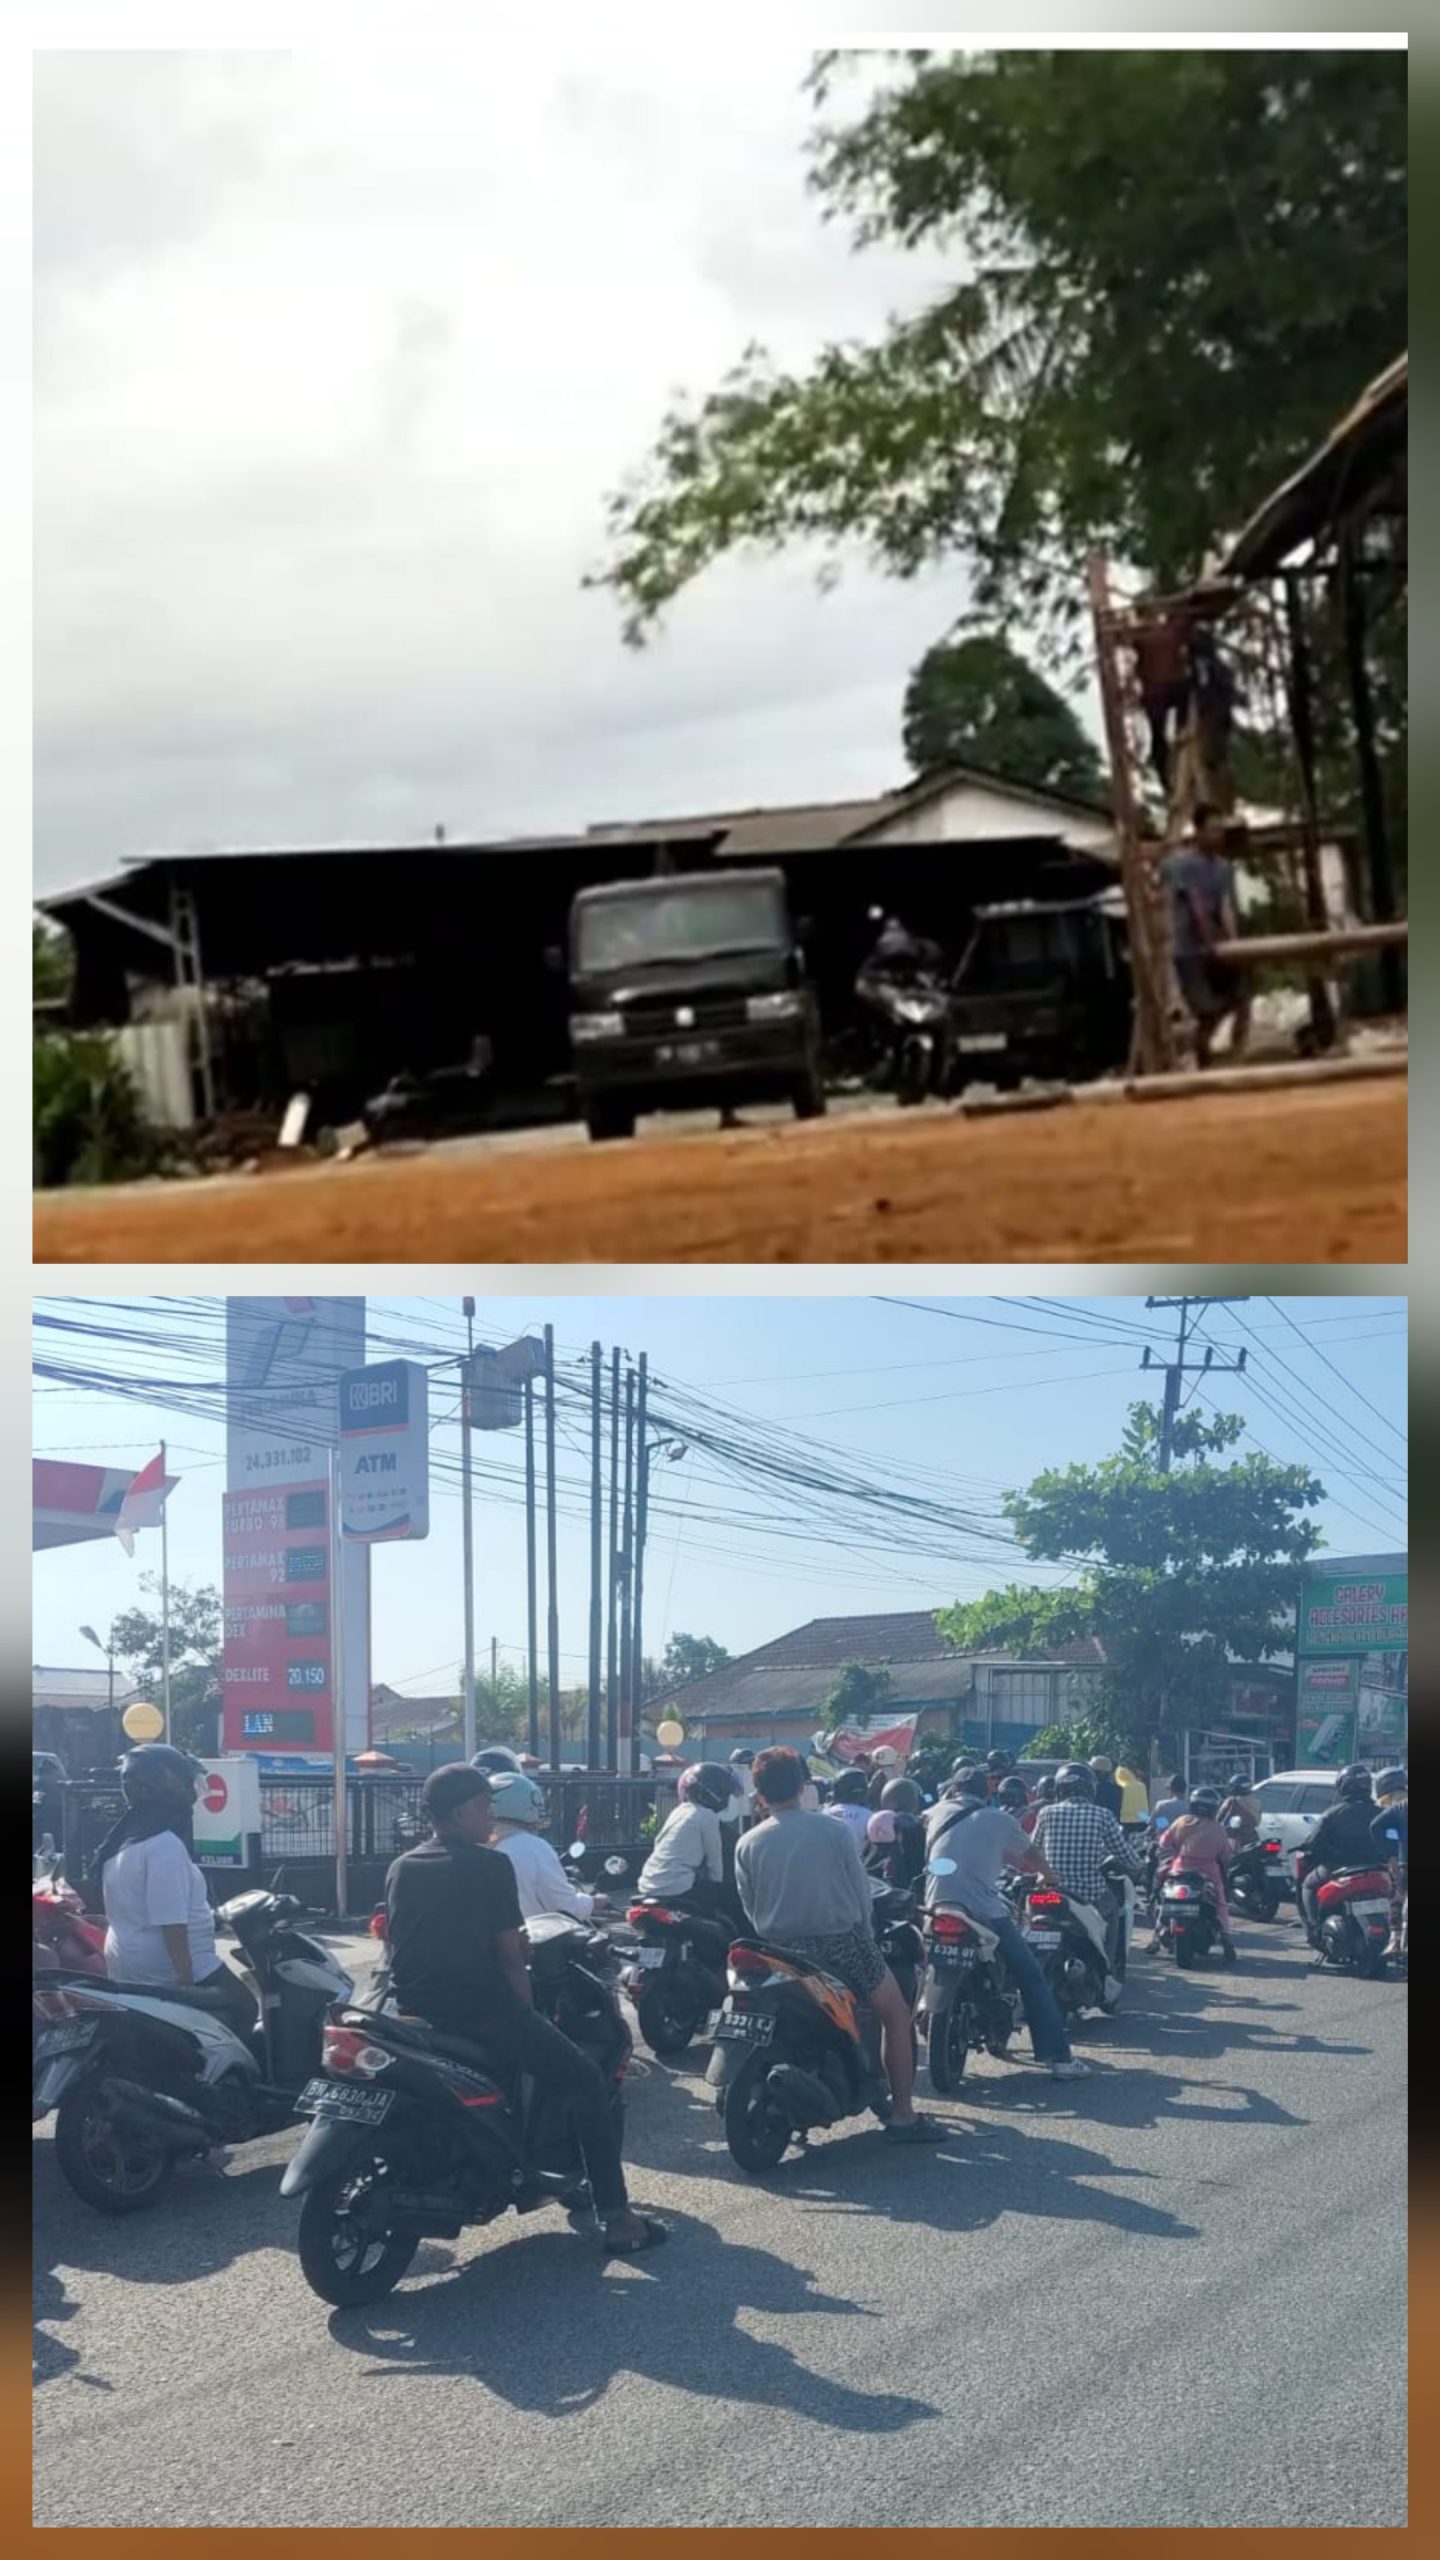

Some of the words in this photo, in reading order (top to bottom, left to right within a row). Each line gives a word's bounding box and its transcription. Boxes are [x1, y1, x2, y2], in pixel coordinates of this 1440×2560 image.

[369, 1380, 397, 1407] BRI
[245, 1446, 312, 1471] 24.331.102
[354, 1452, 397, 1475] ATM
[224, 1496, 286, 1517] PERTAMAX
[225, 1516, 263, 1534] TURBO
[224, 1550, 286, 1570] PERTAMAX
[269, 1567, 287, 1584] 92
[1335, 1584, 1385, 1604] GALERY
[224, 1603, 286, 1621] PERTAMINA
[225, 1622, 246, 1639] DEX
[225, 1667, 270, 1683] DEXLITE
[288, 1667, 325, 1685] 20.150
